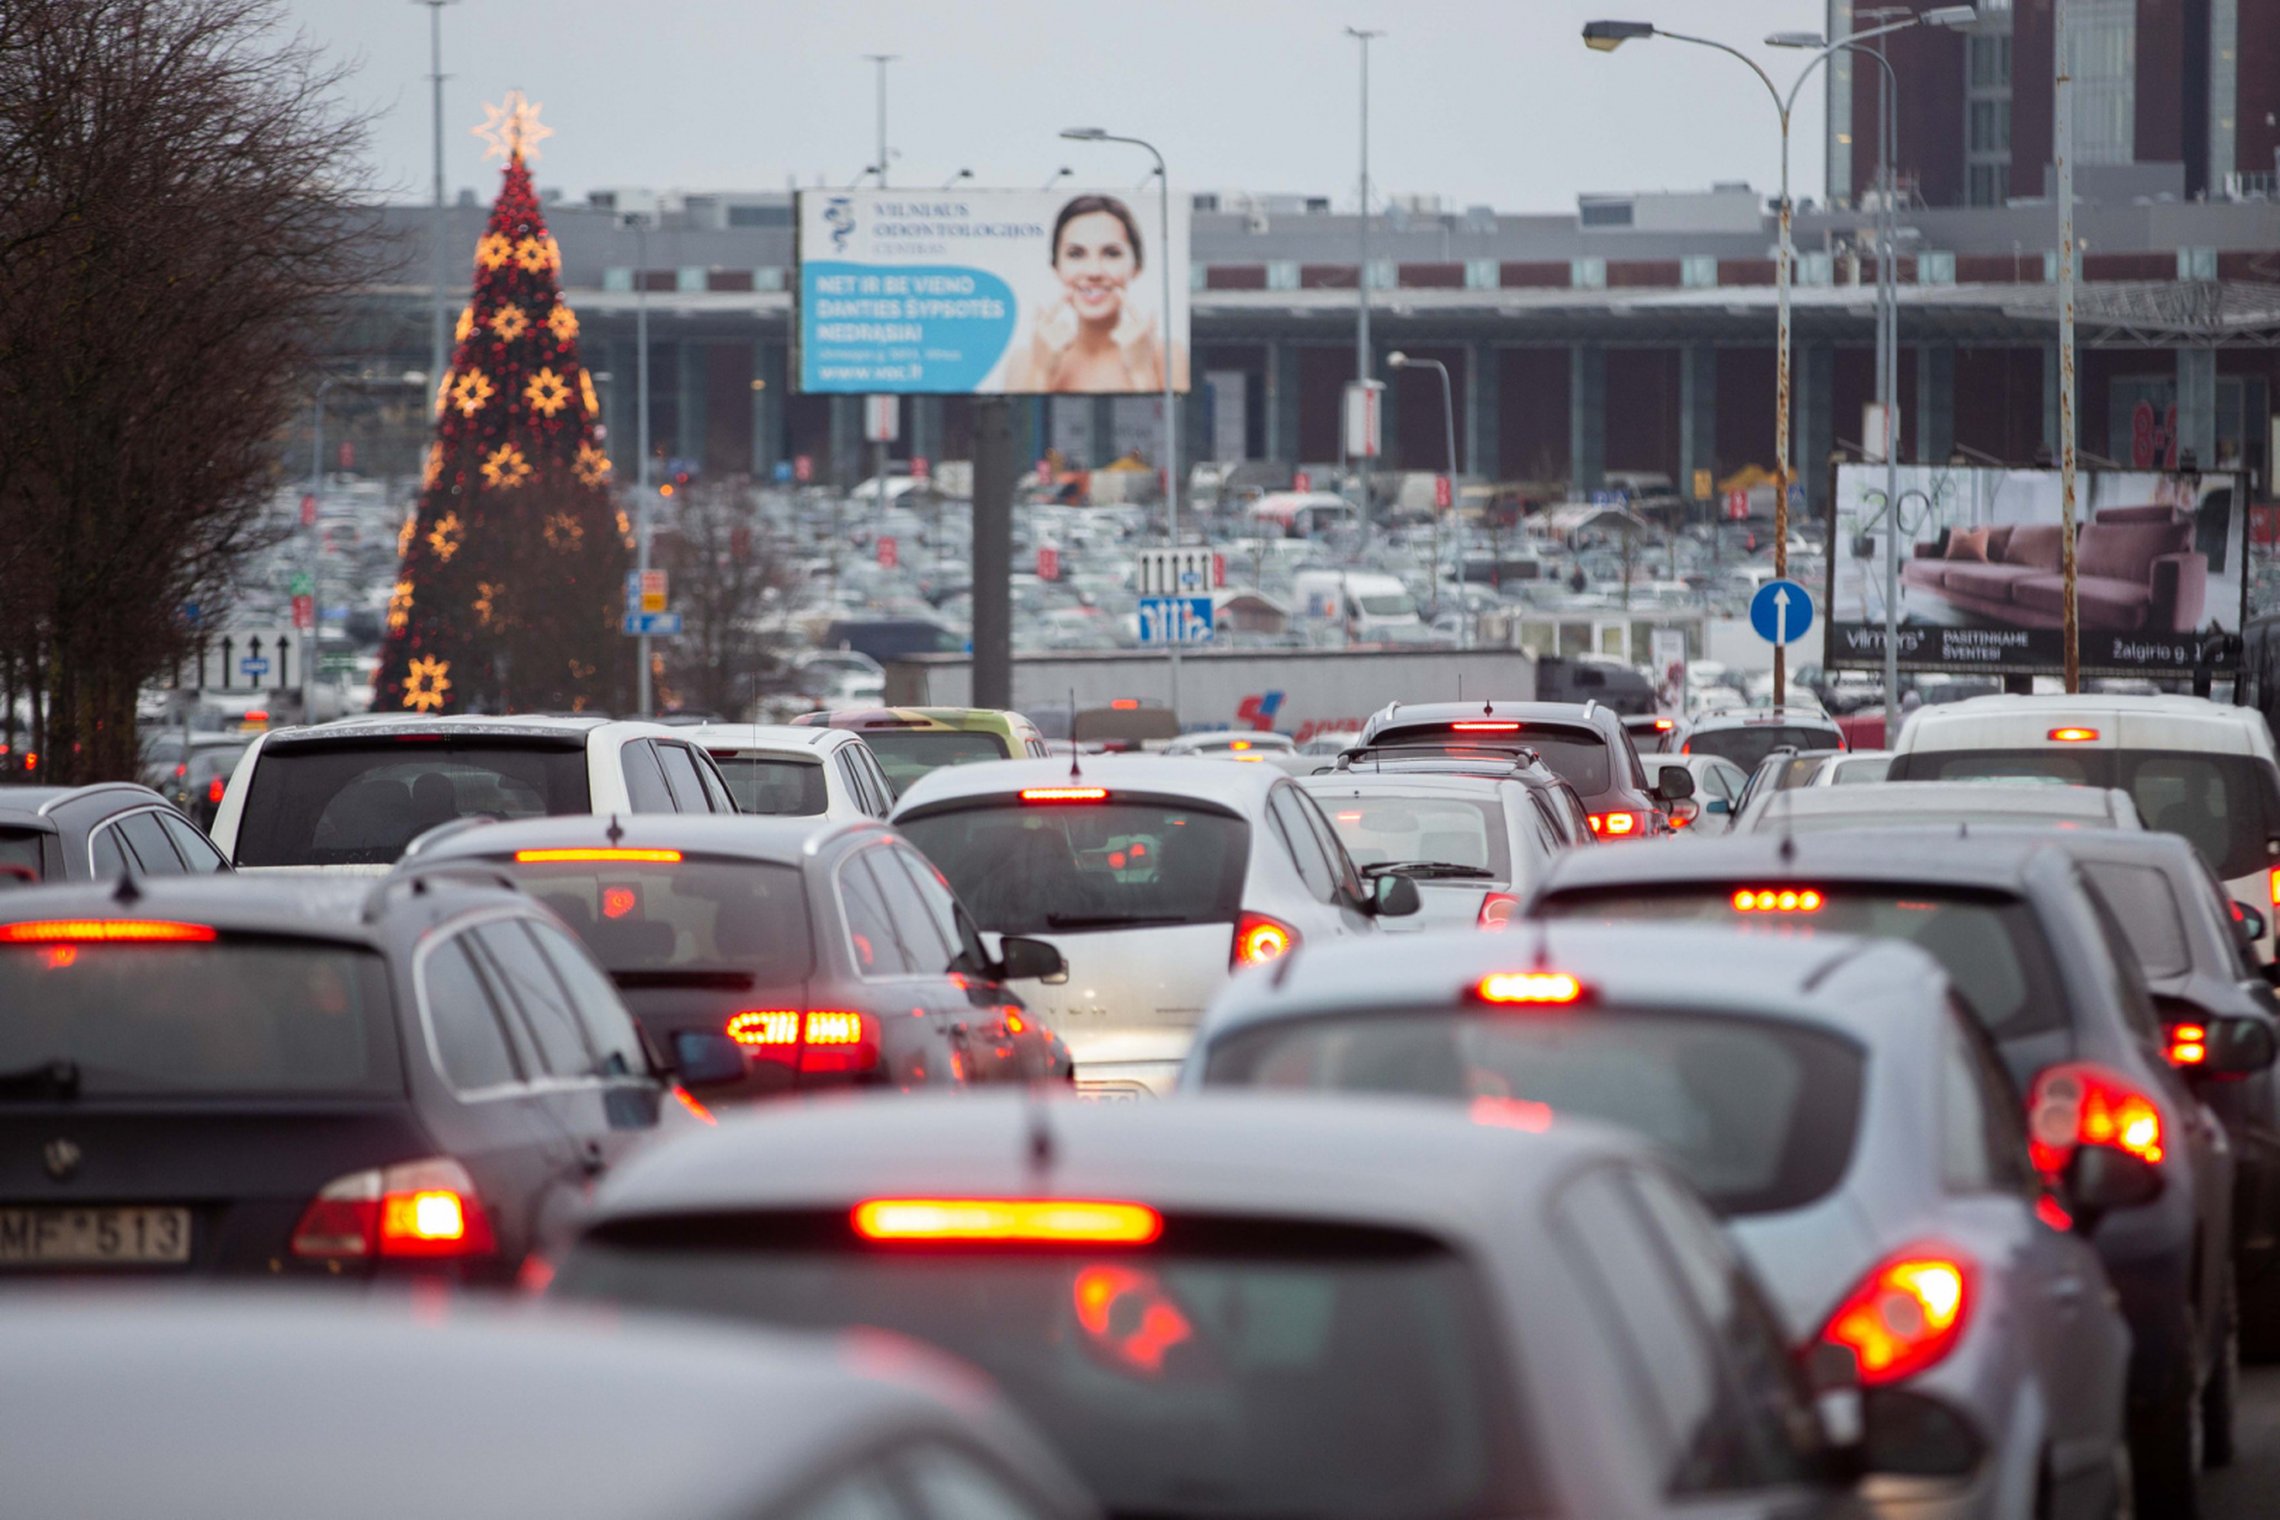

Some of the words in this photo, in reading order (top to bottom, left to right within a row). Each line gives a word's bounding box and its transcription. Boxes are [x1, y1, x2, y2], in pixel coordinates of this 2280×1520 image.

[873, 203, 970, 217] VILNIAUS
[816, 275, 857, 294] NET
[861, 275, 881, 294] IR
[884, 275, 909, 294] BE
[914, 275, 975, 294] VIENO
[816, 299, 901, 319] DANTIES
[2112, 636, 2171, 664] Žalgirio
[97, 1209, 181, 1254] 513
